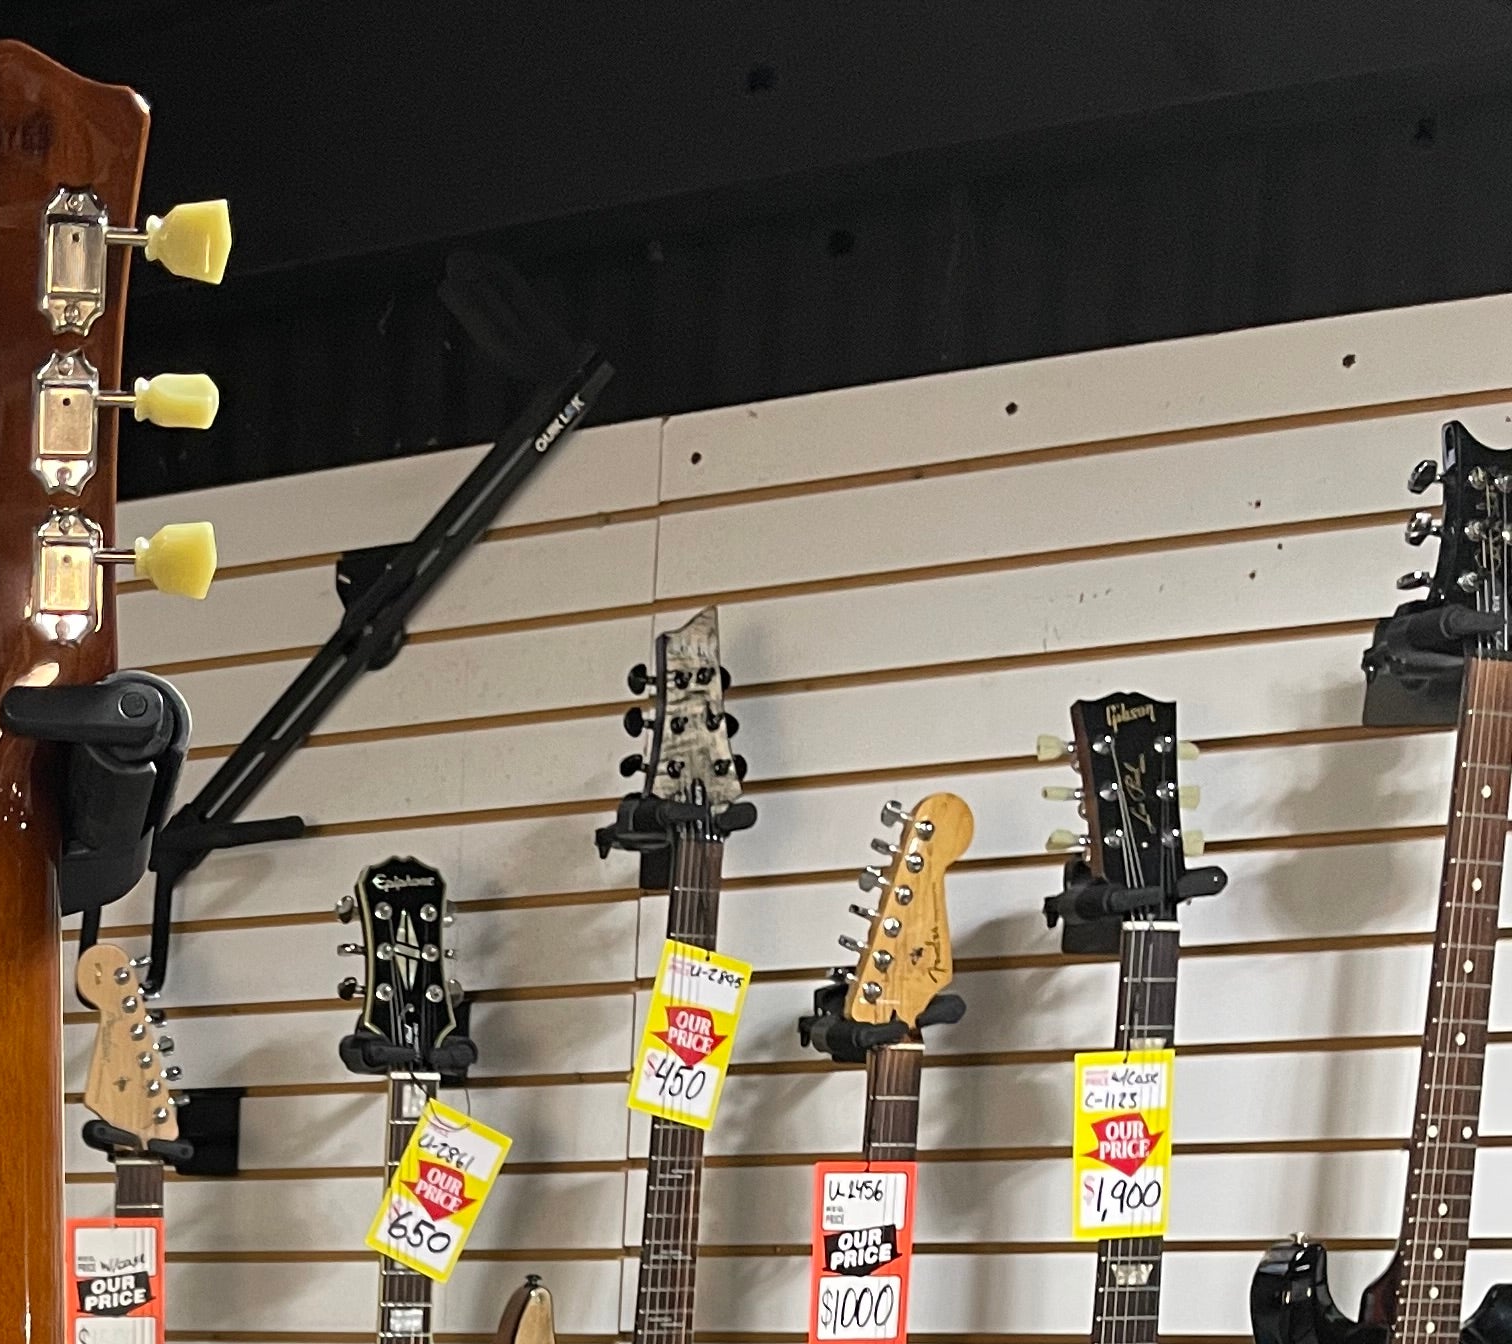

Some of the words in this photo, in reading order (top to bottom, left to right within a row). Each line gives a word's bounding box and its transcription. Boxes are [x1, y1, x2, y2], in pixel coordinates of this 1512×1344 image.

[1106, 703, 1156, 733] Gibson
[675, 1010, 712, 1036] OUR
[667, 1026, 714, 1055] PRICE
[645, 1052, 707, 1101] $450
[1105, 1120, 1144, 1141] OUR
[1099, 1139, 1151, 1161] PRICE
[415, 1177, 463, 1214] PRICE
[426, 1166, 463, 1197] OUR
[1083, 1175, 1162, 1223] $1,900
[837, 1228, 882, 1252] OUR
[829, 1243, 893, 1271] PRICE
[90, 1274, 136, 1295] OUR
[84, 1288, 148, 1312] PRICE
[821, 1284, 895, 1336] $1000
